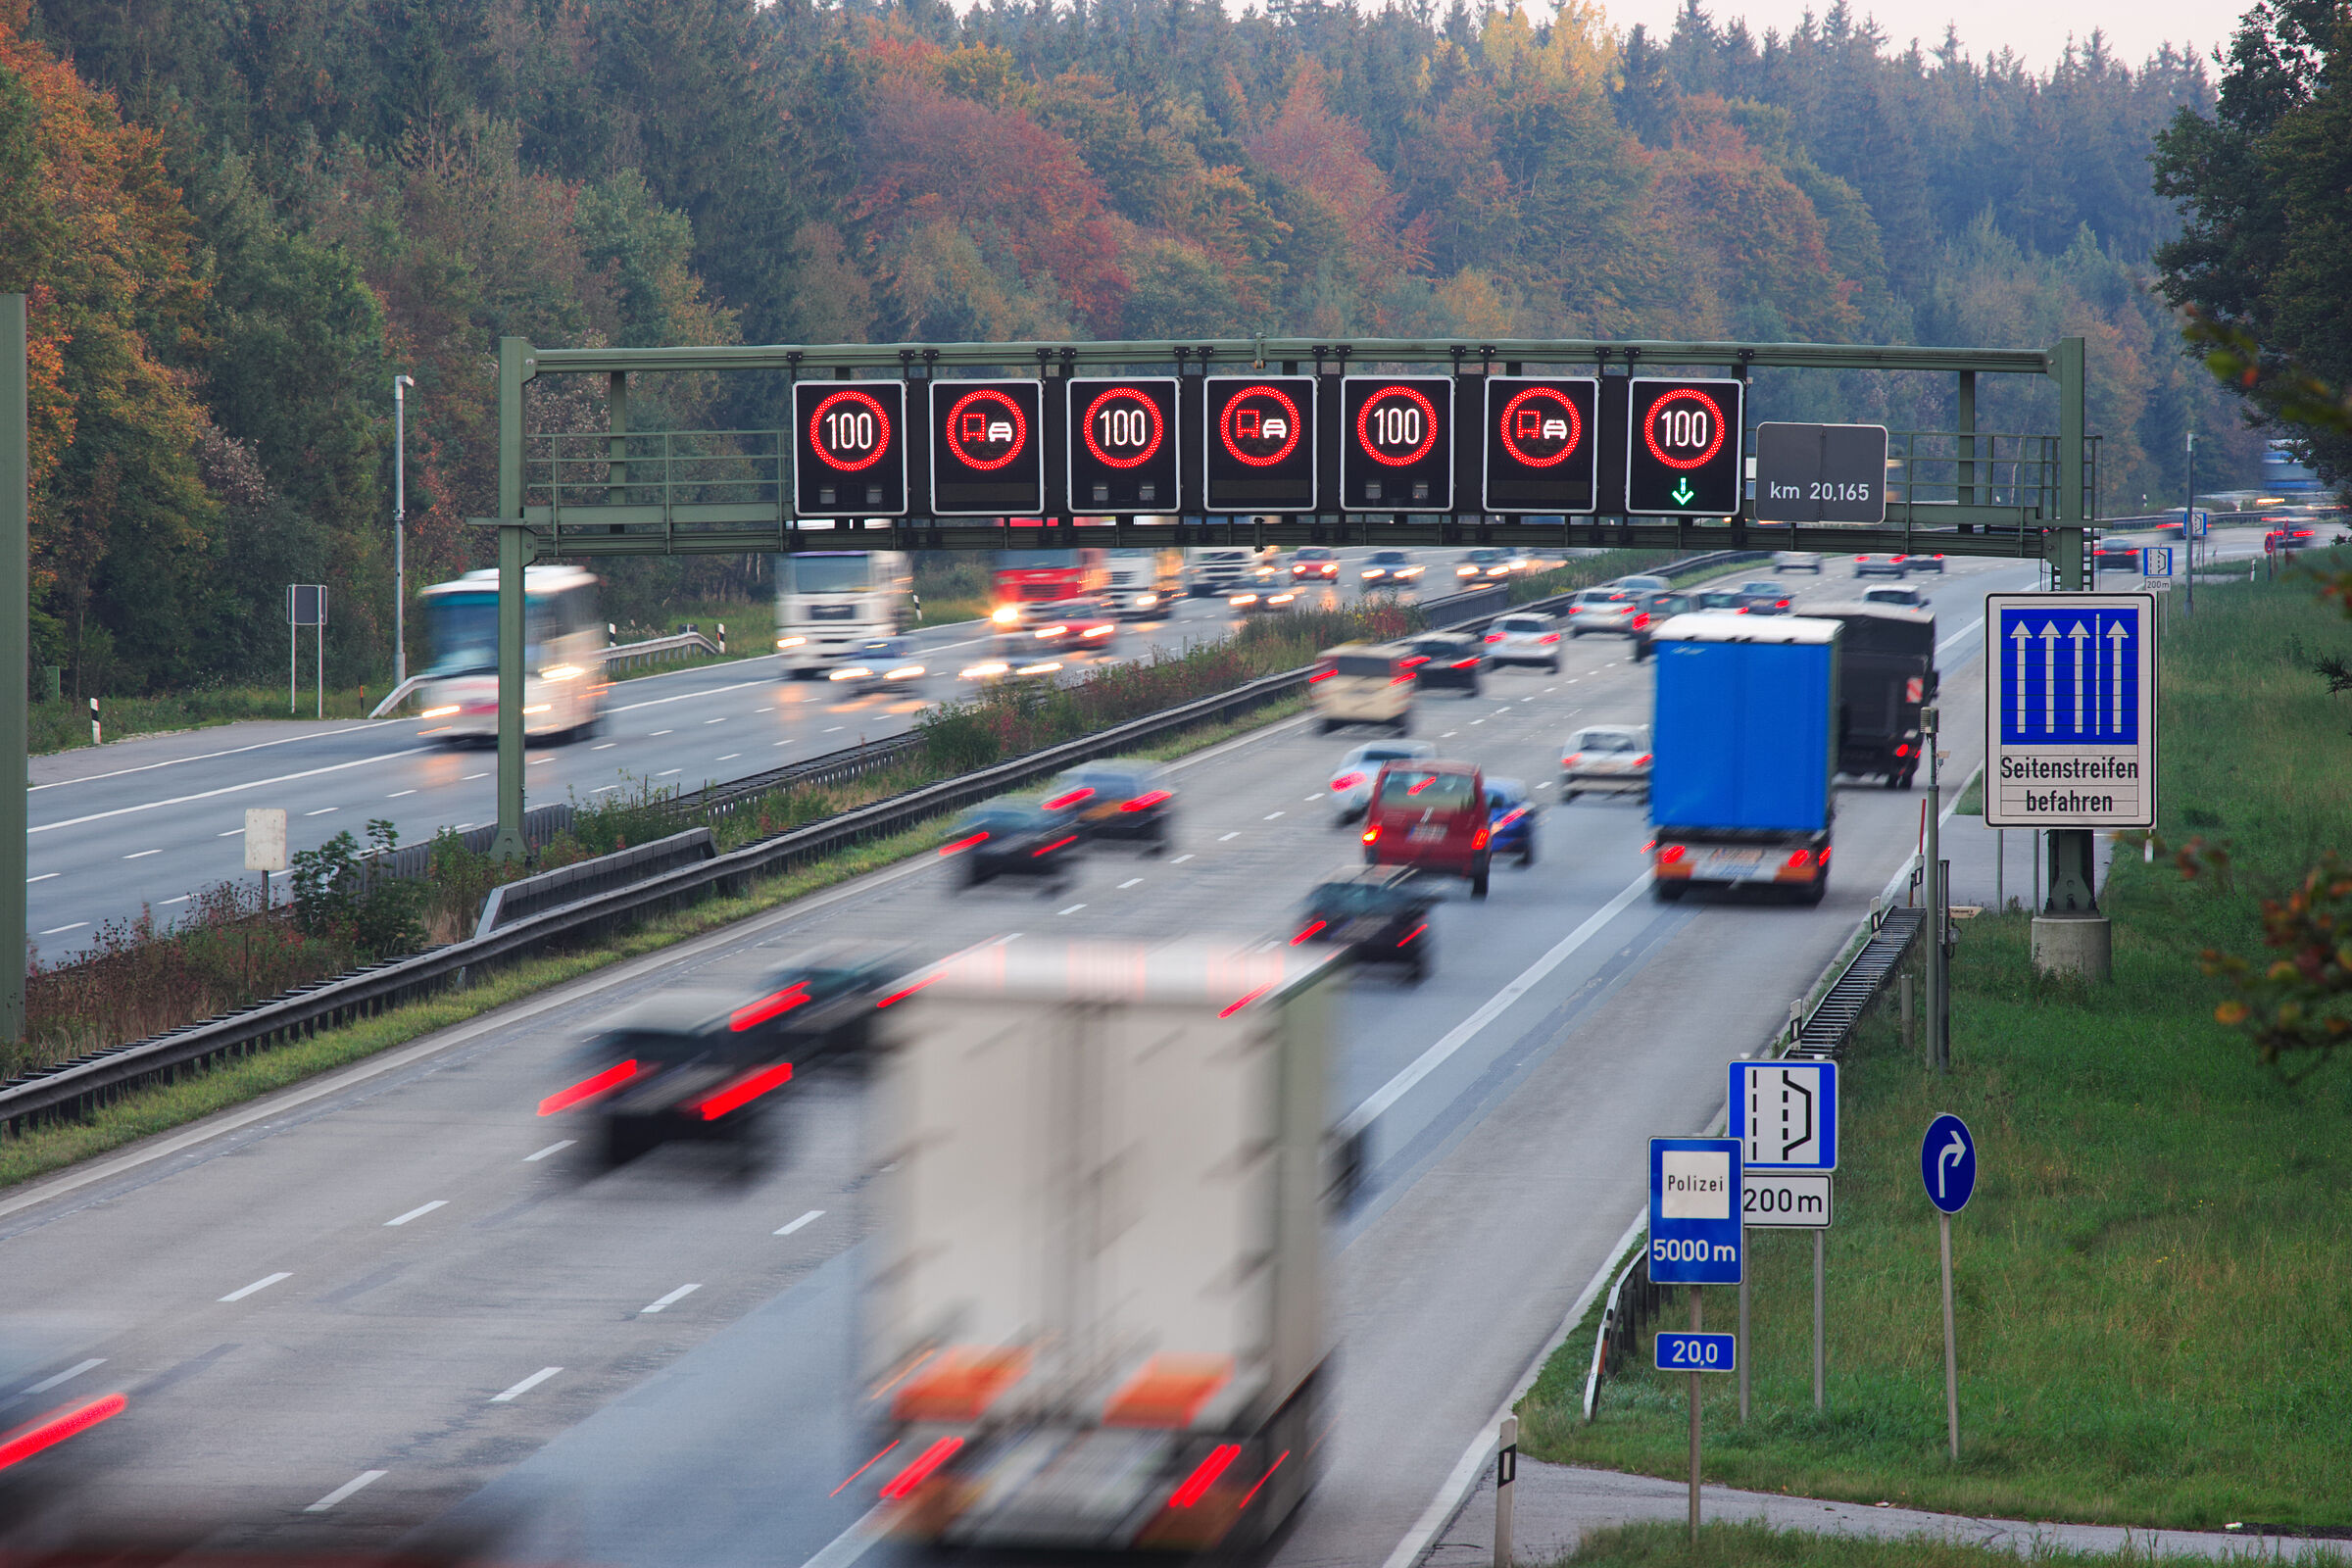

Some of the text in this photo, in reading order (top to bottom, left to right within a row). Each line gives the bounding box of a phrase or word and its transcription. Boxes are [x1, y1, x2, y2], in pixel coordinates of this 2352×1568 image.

[825, 412, 873, 450] 100
[1099, 409, 1147, 447] 100
[1373, 408, 1420, 446] 100
[1660, 410, 1707, 448] 100
[1770, 480, 1870, 502] km 20,165
[2000, 756, 2138, 779] Seitenstreifen
[2026, 789, 2113, 812] befahren
[1668, 1174, 1723, 1192] Polizei
[1653, 1239, 1709, 1262] 5000
[1672, 1340, 1718, 1366] 20,0
